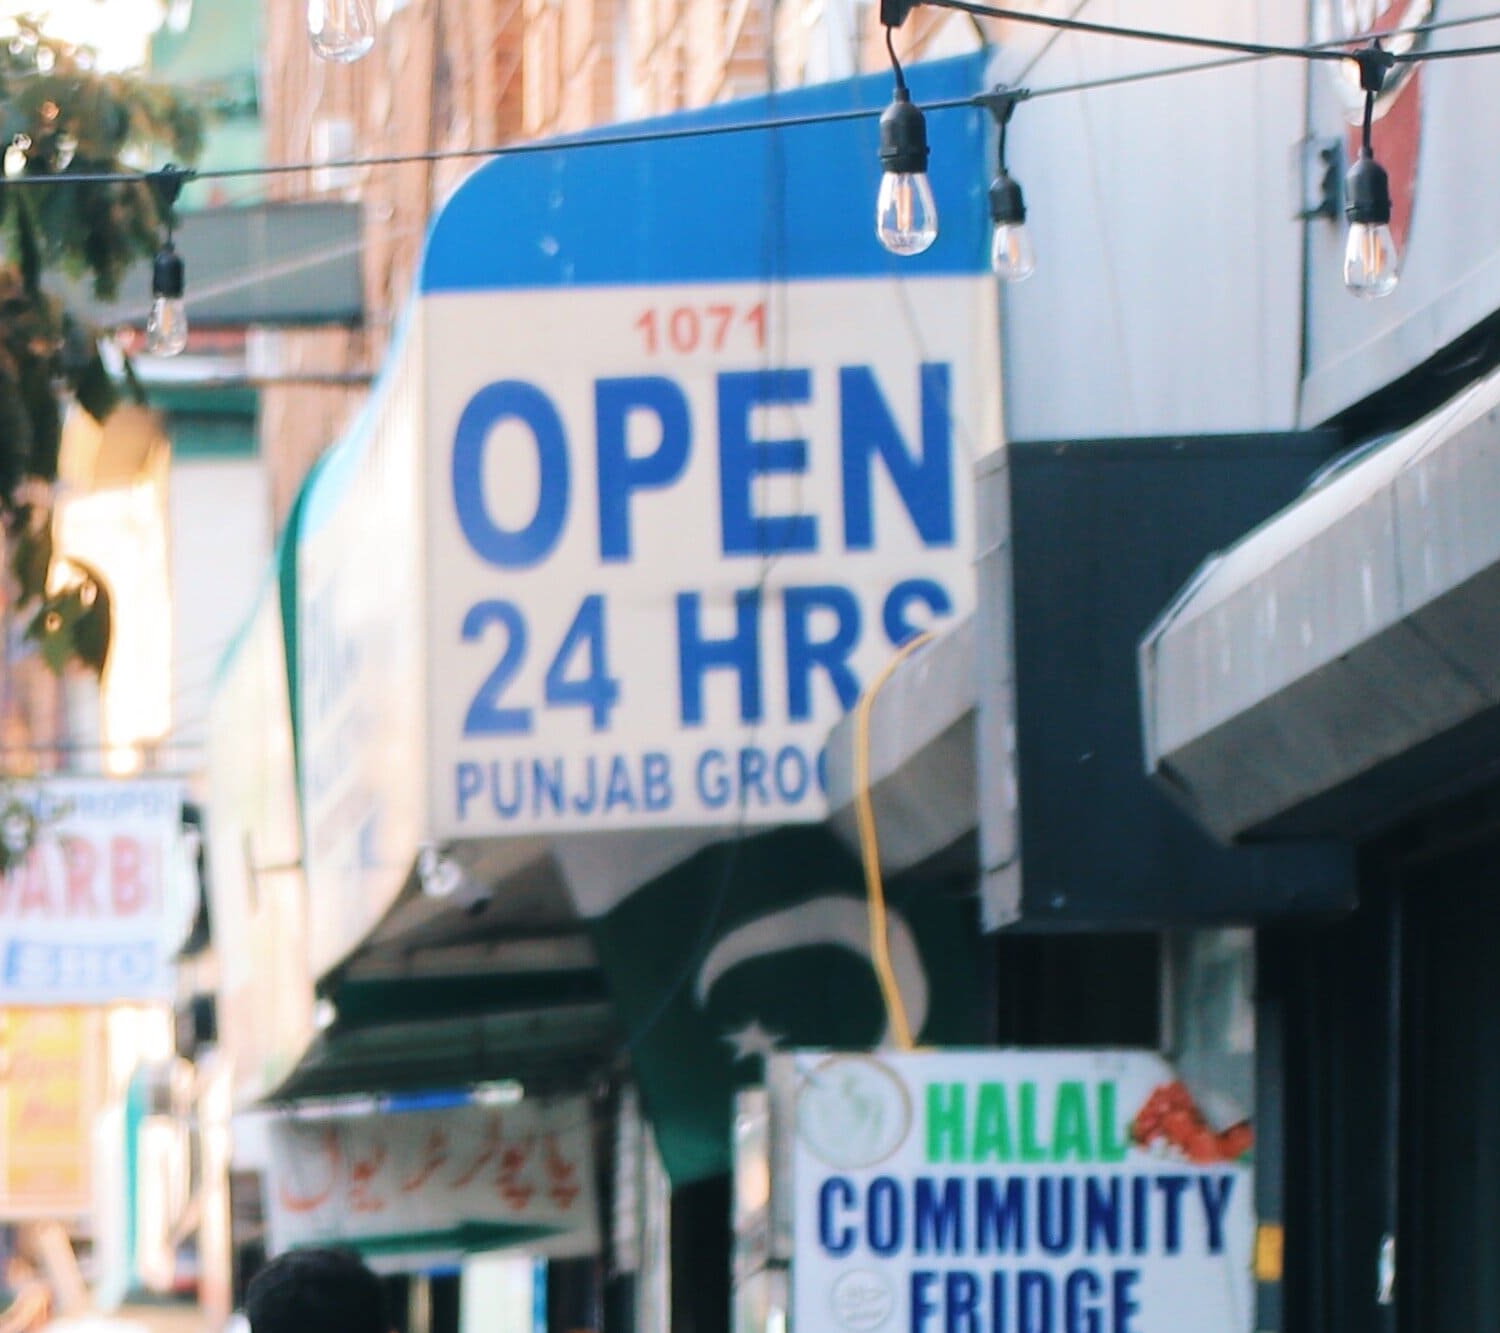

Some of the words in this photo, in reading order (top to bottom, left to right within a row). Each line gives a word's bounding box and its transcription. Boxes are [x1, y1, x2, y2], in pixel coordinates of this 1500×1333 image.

[634, 303, 768, 355] 1071
[451, 362, 955, 573] OPEN
[460, 594, 618, 739] 24
[454, 751, 673, 822] PUNJAB
[925, 1081, 1128, 1163] HALAL
[817, 1174, 1235, 1257] COMMUNITY
